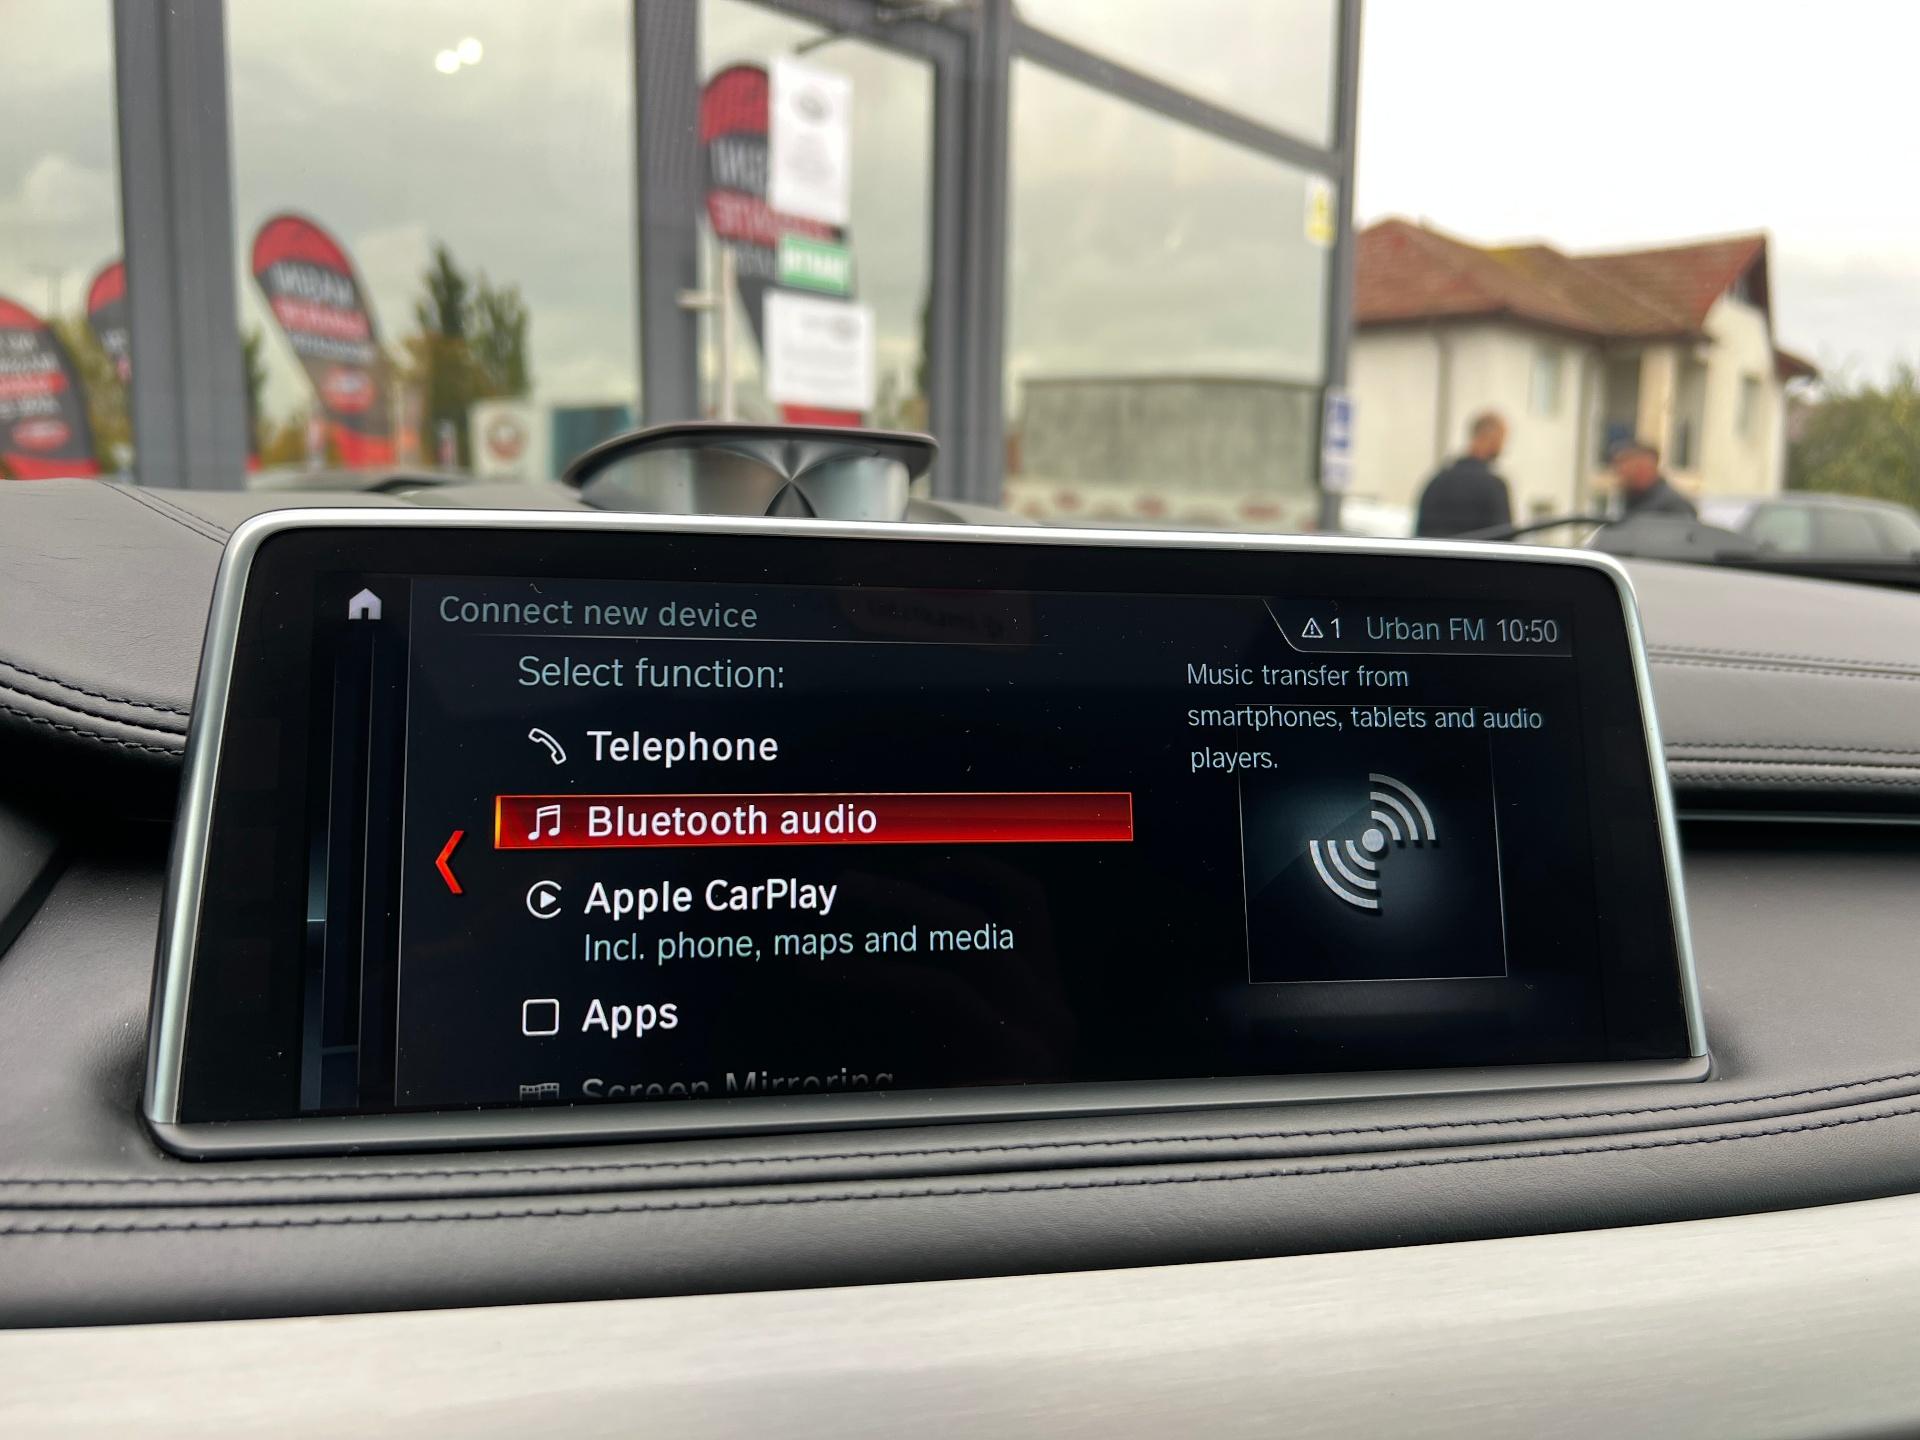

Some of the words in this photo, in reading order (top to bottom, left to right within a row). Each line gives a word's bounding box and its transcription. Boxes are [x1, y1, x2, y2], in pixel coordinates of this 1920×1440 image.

[439, 594, 574, 625] Connect
[584, 604, 649, 626] new
[658, 601, 758, 628] device
[1330, 617, 1340, 639] 1
[1366, 616, 1440, 641] Urban
[1449, 617, 1485, 642] FM
[1496, 618, 1558, 643] 10:50
[518, 655, 624, 687] Select
[635, 657, 784, 689] function:
[1187, 663, 1254, 686] Music
[1261, 664, 1350, 687] transfer
[1356, 664, 1409, 687] from
[1187, 705, 1344, 733] smartphones,
[1351, 705, 1427, 728] tablets
[1434, 707, 1475, 729] and
[1483, 707, 1543, 729] audio
[586, 730, 779, 769] Telephone
[1191, 746, 1278, 774] players.
[588, 804, 767, 837] Bluetooth
[780, 803, 877, 835] audio
[582, 879, 693, 918] Apple
[705, 876, 839, 917] CarPlay
[583, 932, 645, 962] Incl.
[657, 931, 761, 967] phone,
[774, 932, 854, 961] maps
[864, 924, 917, 953] and
[929, 922, 1014, 952] media
[581, 998, 679, 1039] Apps
